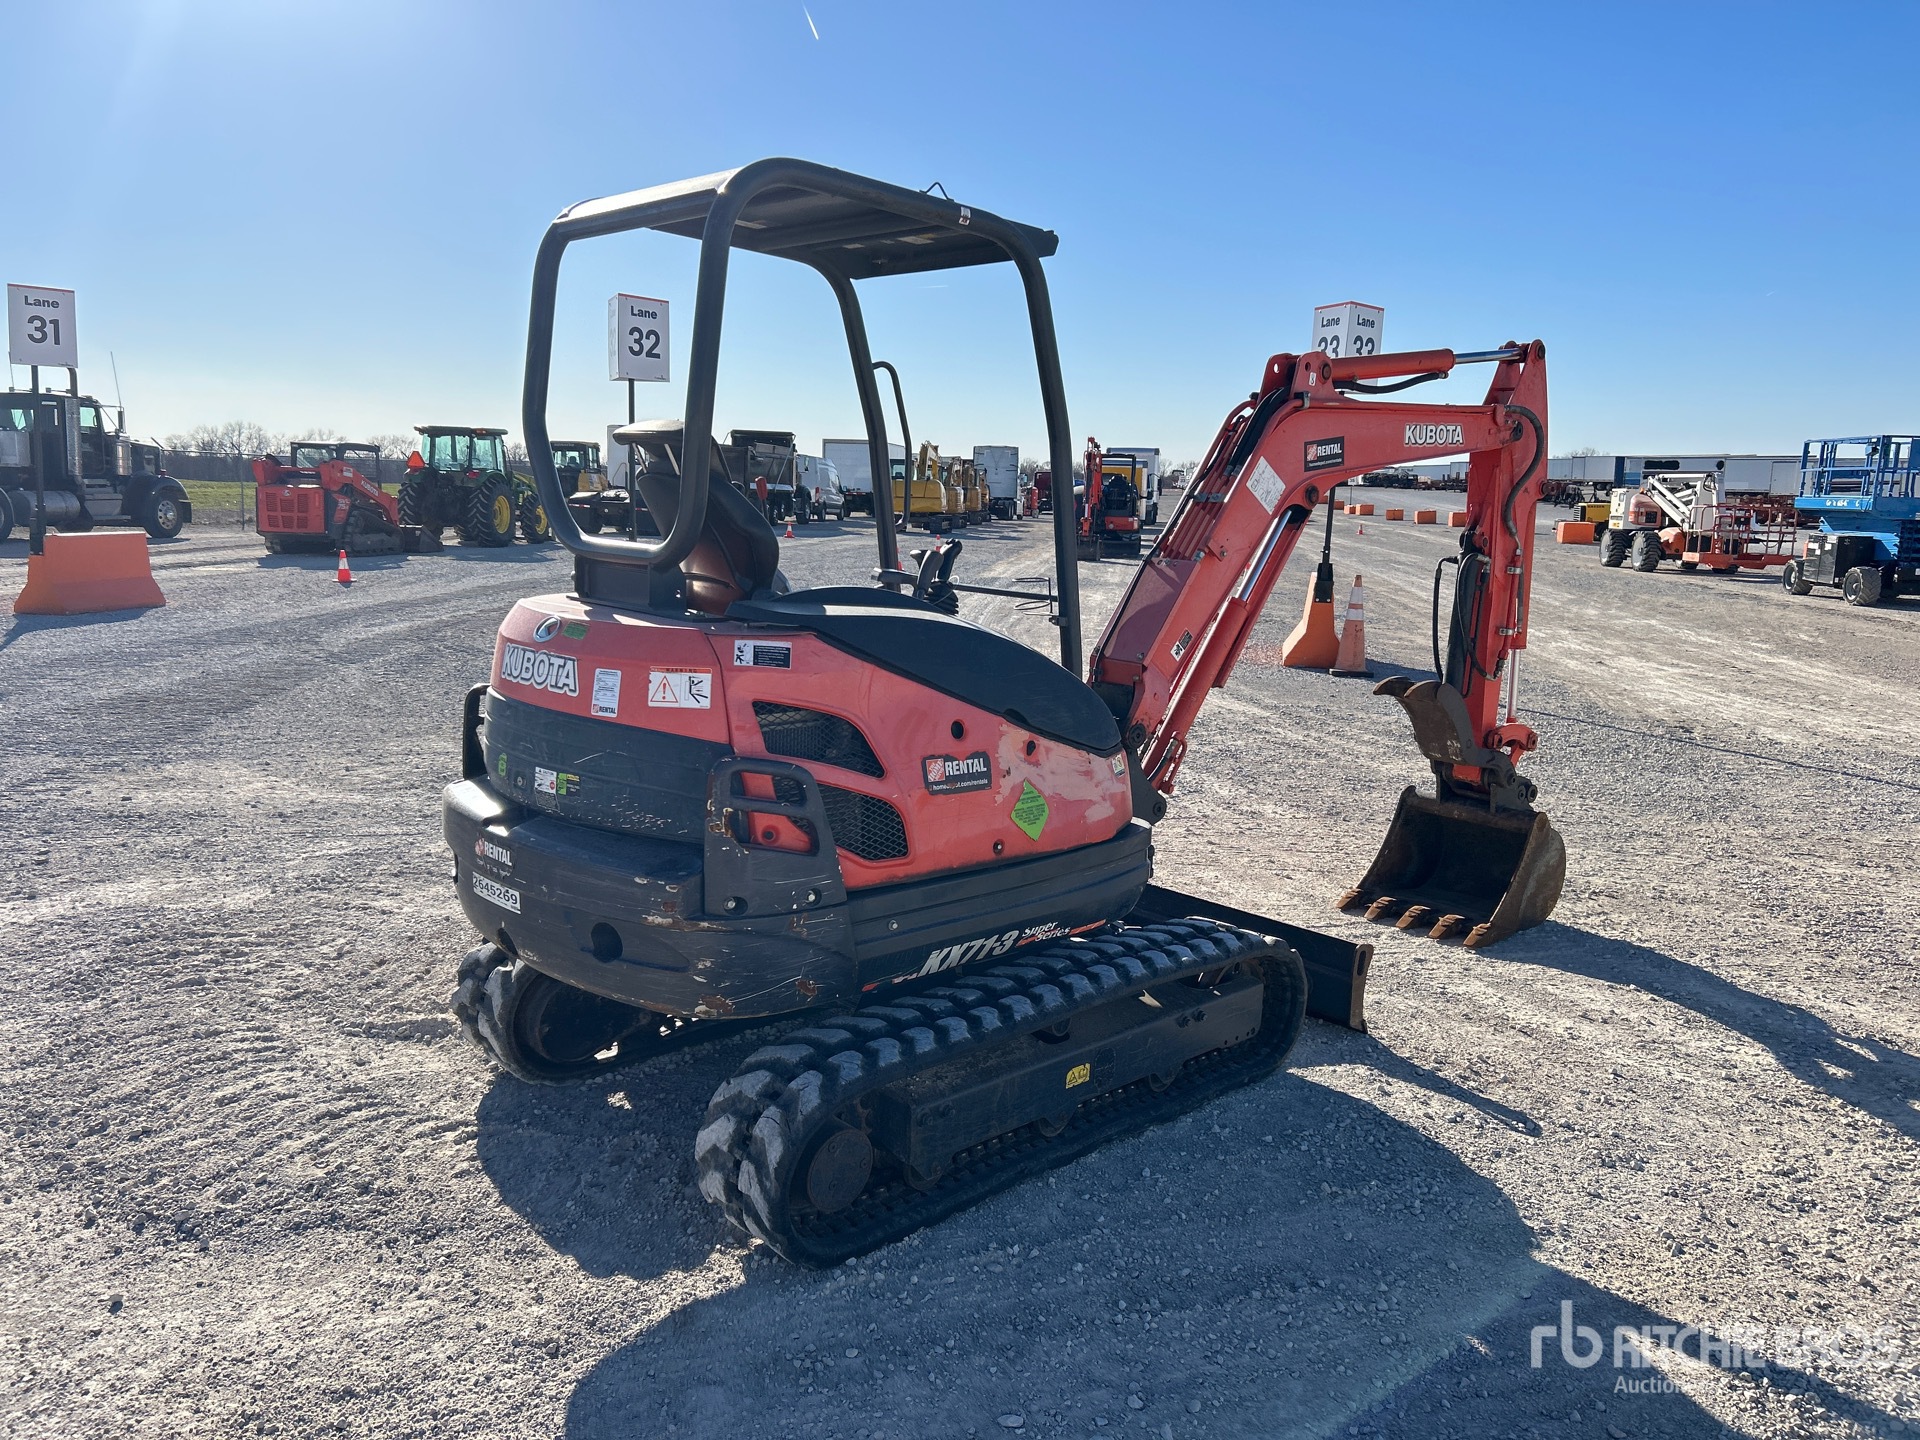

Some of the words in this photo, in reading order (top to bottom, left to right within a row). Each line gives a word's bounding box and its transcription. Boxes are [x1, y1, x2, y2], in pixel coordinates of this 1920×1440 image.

[24, 295, 60, 309] Lane
[630, 305, 658, 320] Lane
[27, 314, 61, 346] 31
[1321, 316, 1341, 329] Lane
[1356, 314, 1376, 329] Lane
[627, 326, 661, 360] 32
[1404, 423, 1464, 446] KUBOTA
[1317, 442, 1343, 457] RENTAL
[502, 643, 577, 694] KUBOTA
[599, 705, 617, 714] RENTAL
[944, 757, 988, 776] RENTAL
[484, 840, 513, 867] RENTAL
[473, 876, 518, 905] 2645269
[917, 930, 1020, 977] KX71-3
